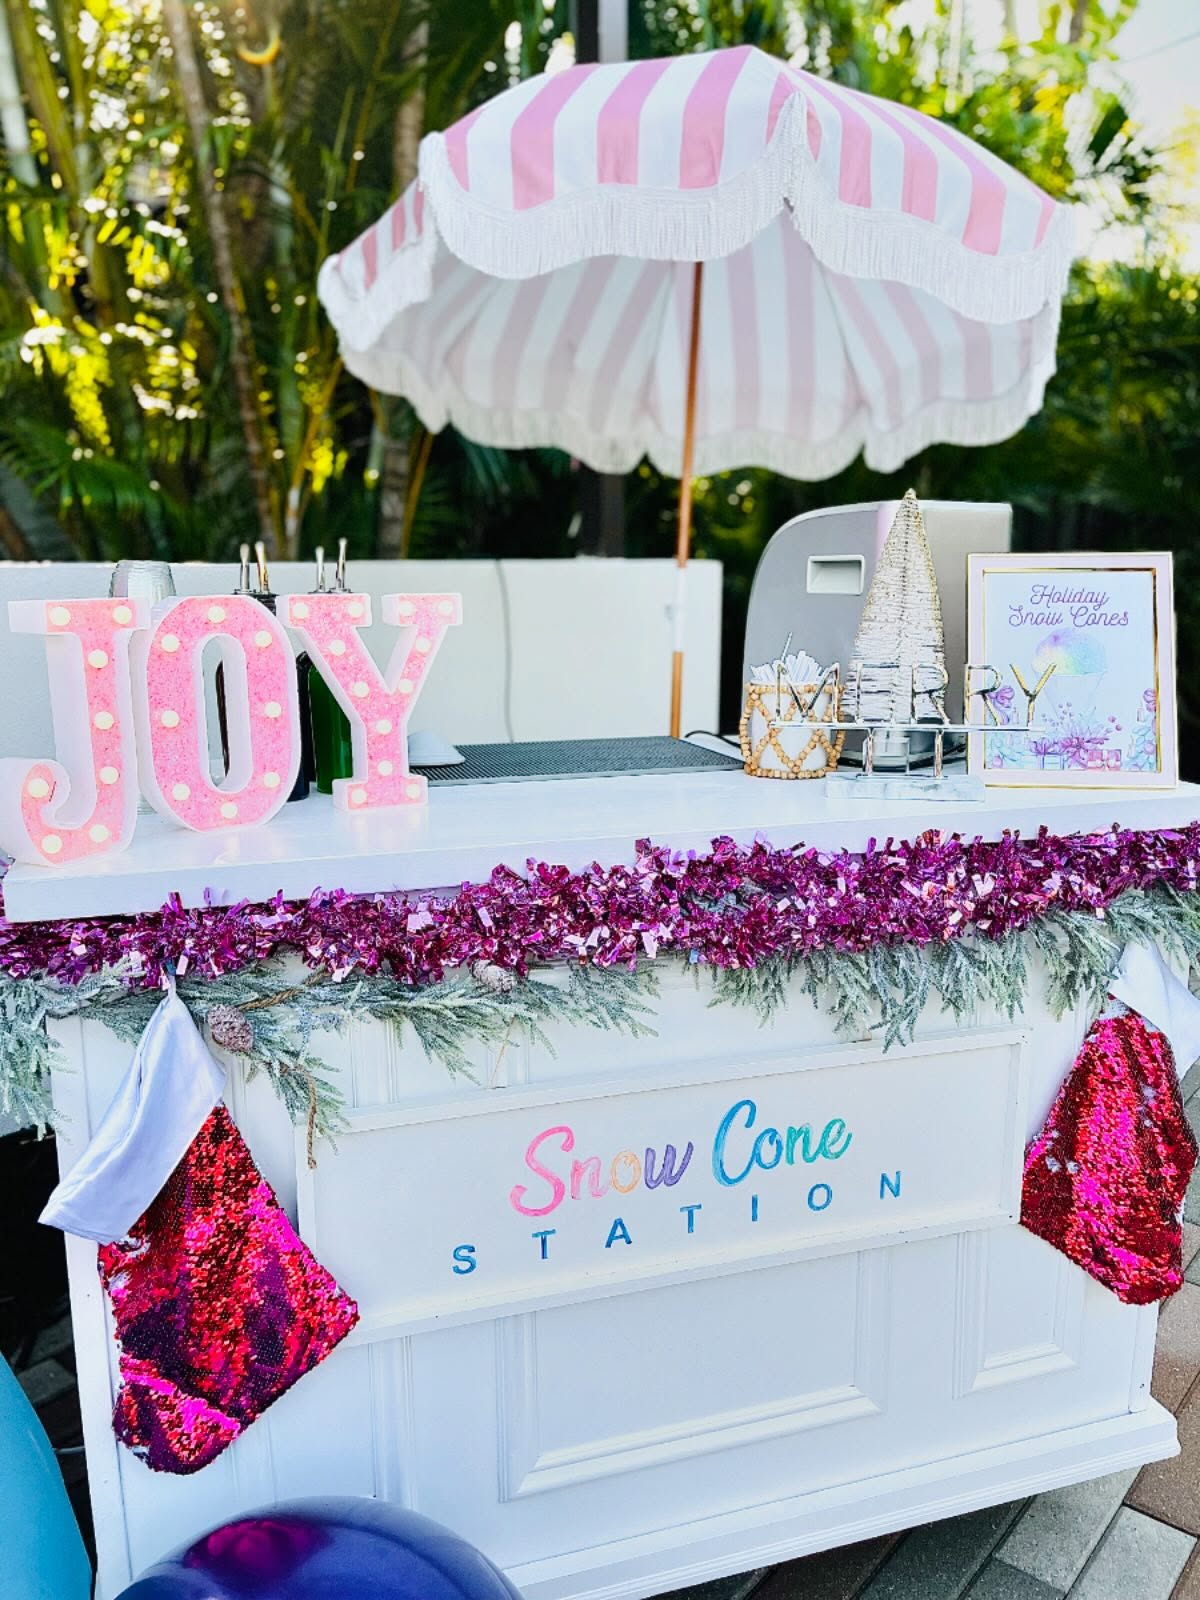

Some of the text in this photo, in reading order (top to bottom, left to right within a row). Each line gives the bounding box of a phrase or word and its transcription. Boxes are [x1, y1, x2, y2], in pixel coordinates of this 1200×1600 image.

[1008, 604, 1129, 628] Snow Cones
[1029, 584, 1110, 610] Holiday
[3, 593, 463, 866] JOY
[771, 662, 1057, 727] MERRY
[509, 1099, 853, 1217] Snow Cone
[452, 1170, 902, 1275] STATION
